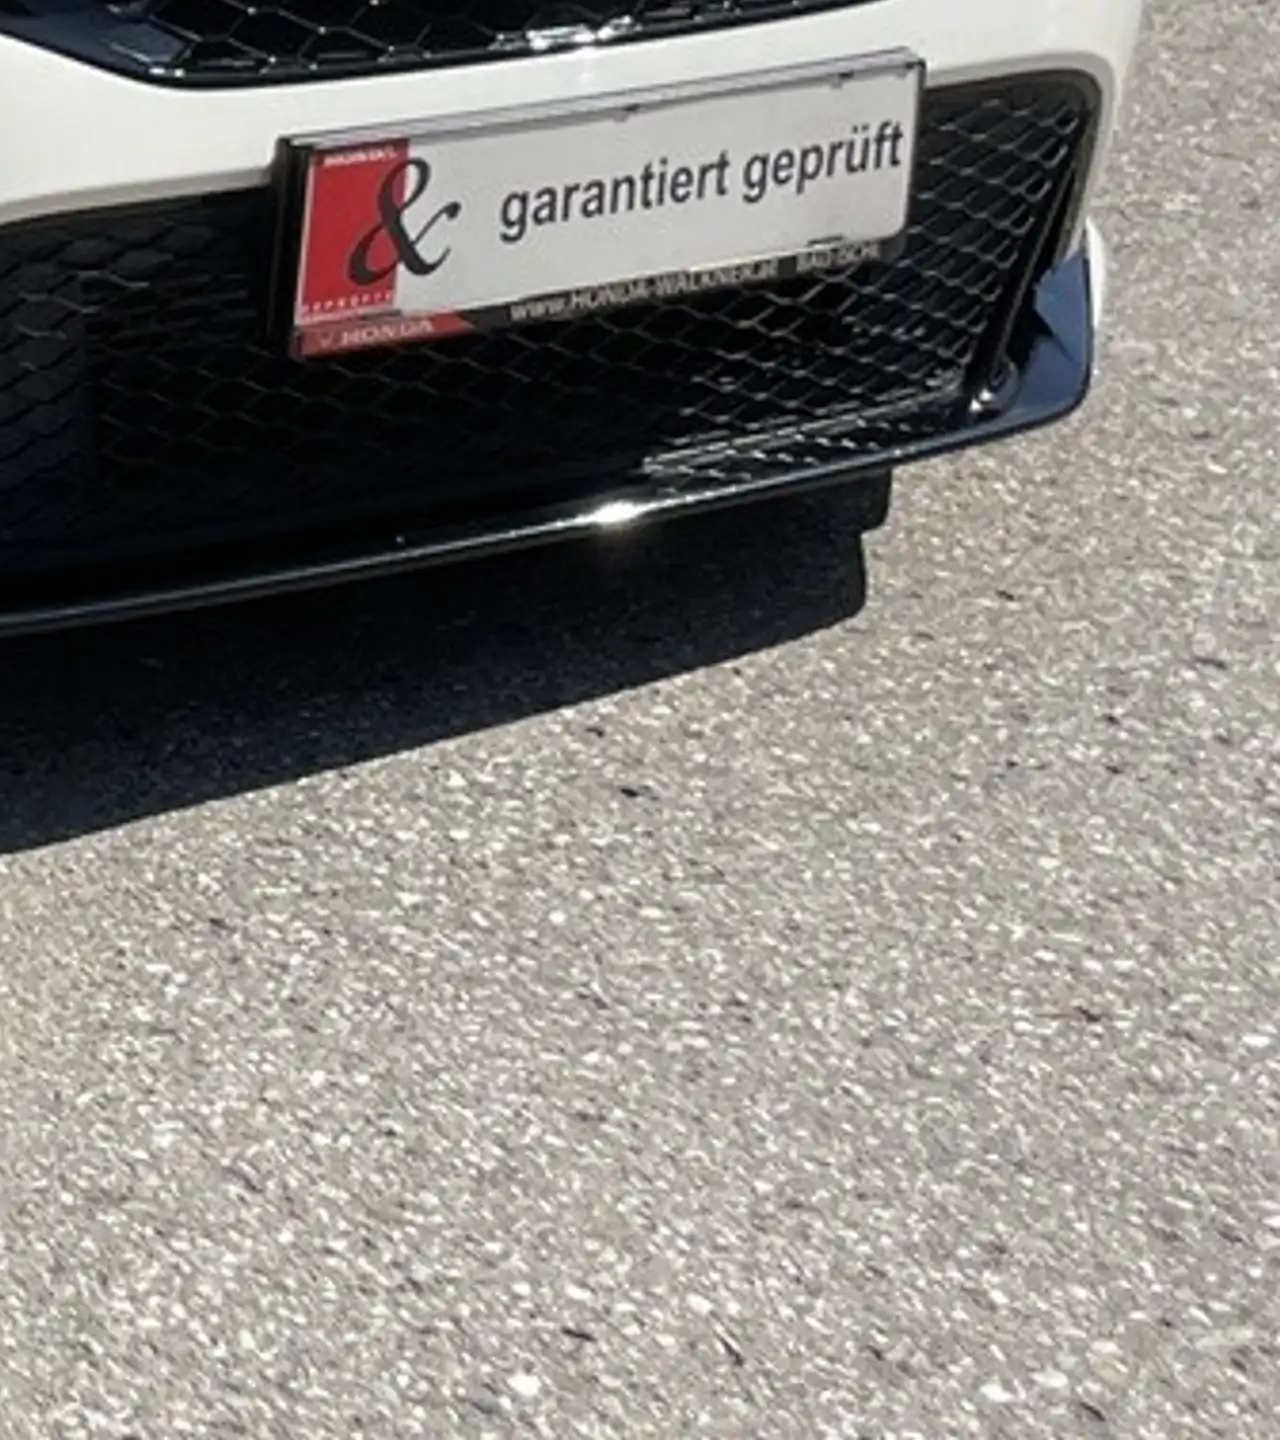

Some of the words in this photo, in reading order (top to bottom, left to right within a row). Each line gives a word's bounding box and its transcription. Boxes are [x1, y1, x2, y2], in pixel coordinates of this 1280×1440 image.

[499, 150, 731, 244] garantiert
[742, 120, 905, 203] geprüft
[342, 319, 433, 346] HONDA
